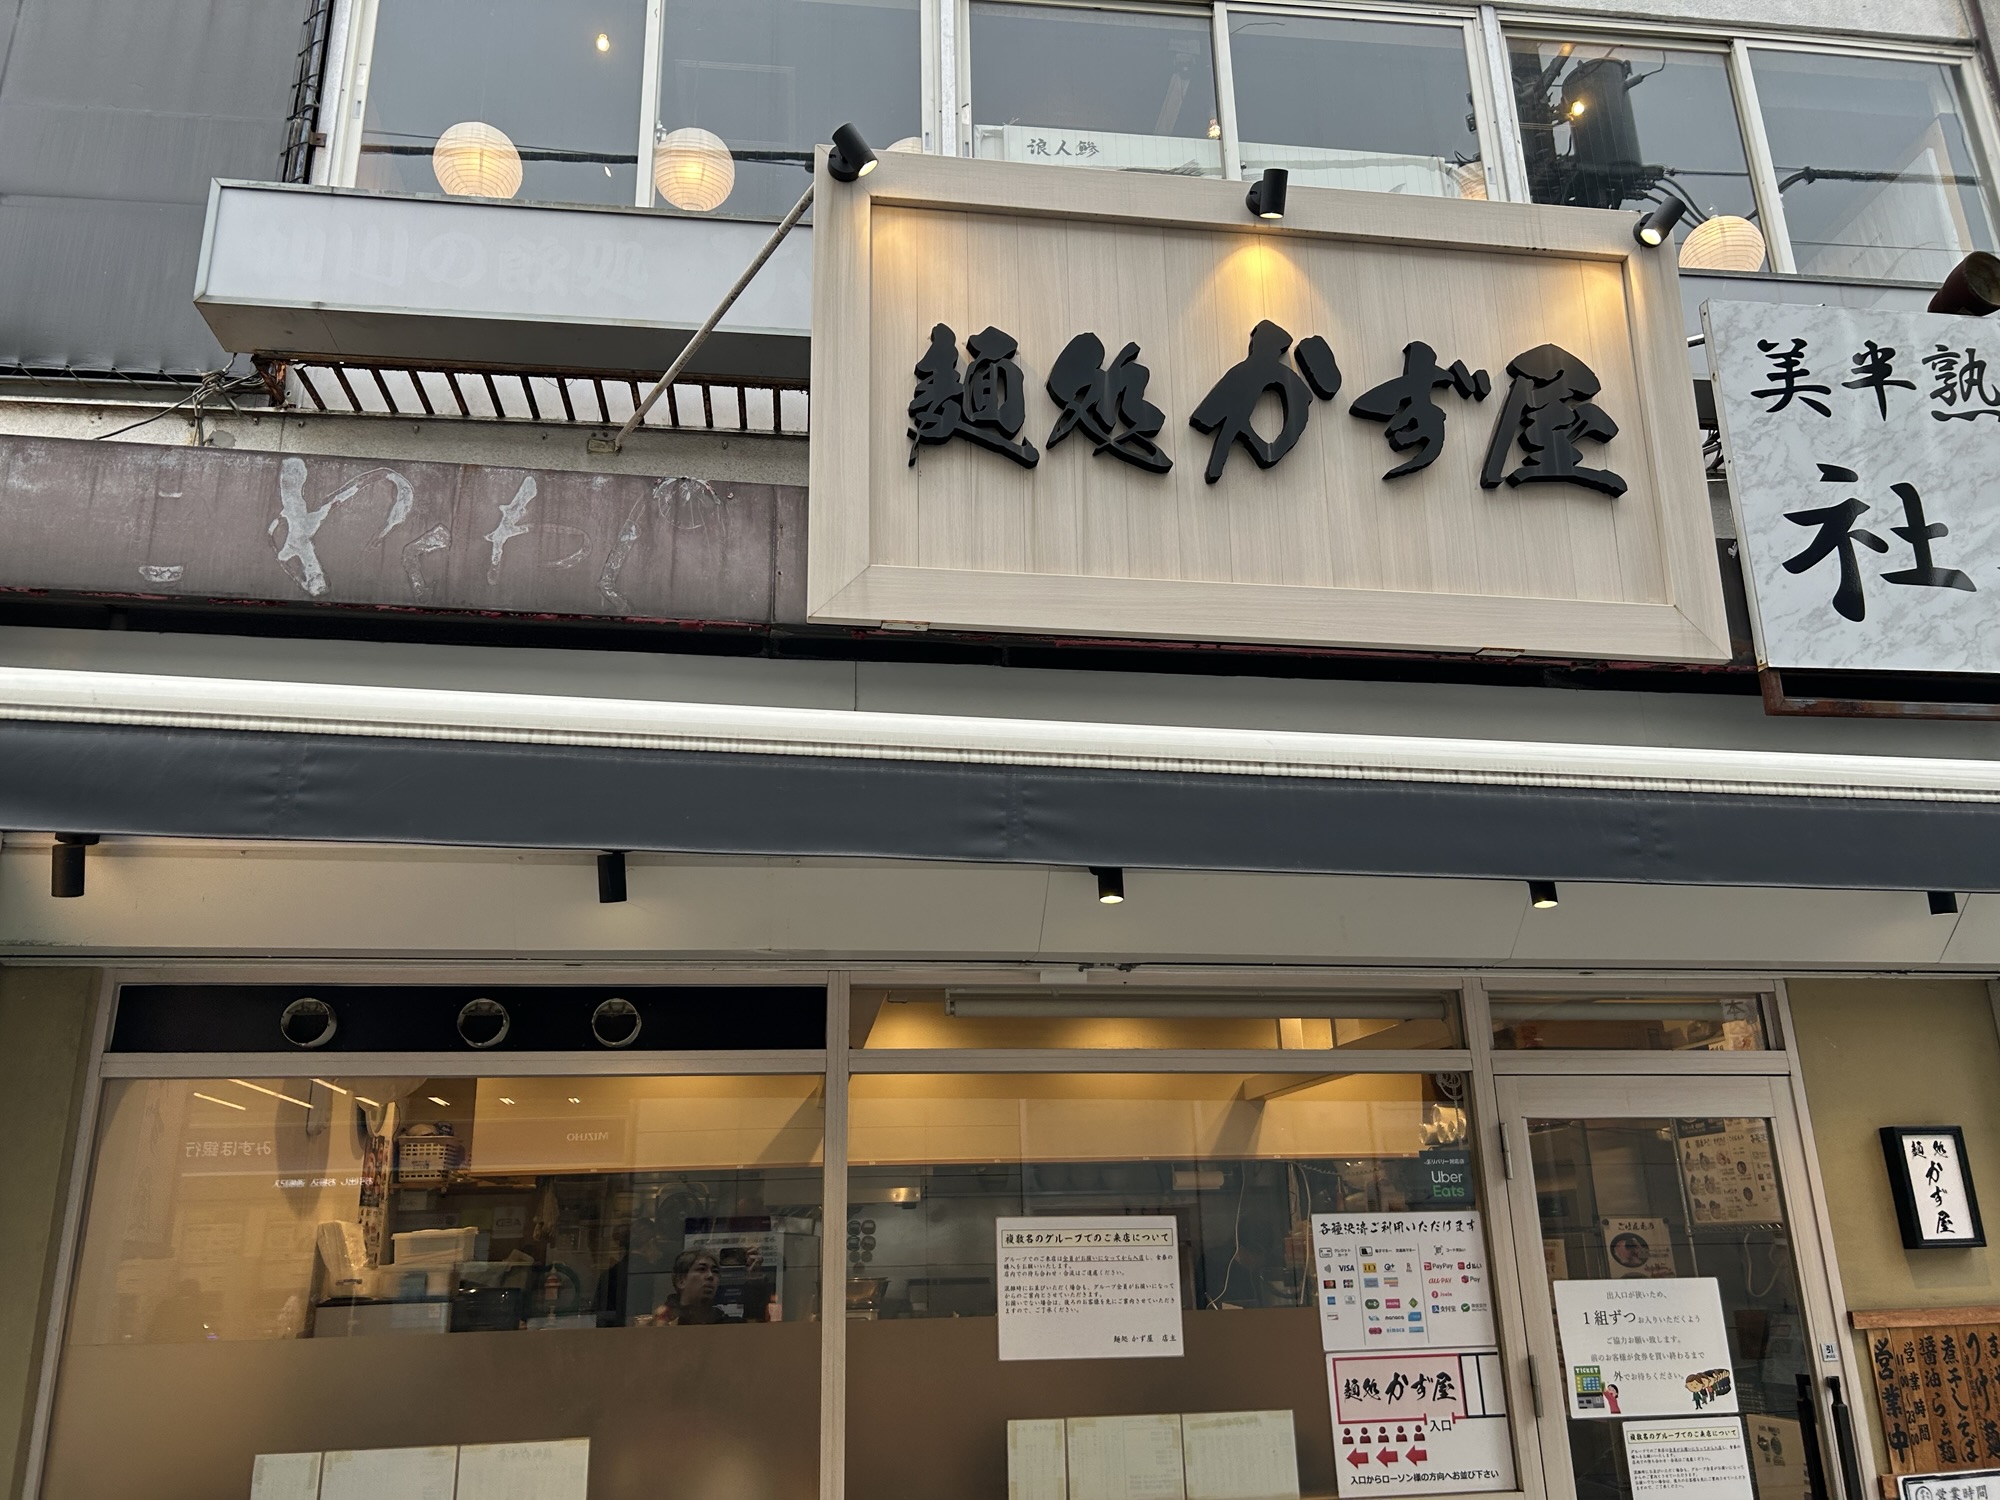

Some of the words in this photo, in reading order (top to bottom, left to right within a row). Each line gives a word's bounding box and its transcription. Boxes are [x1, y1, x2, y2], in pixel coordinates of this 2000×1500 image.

[1431, 1171, 1463, 1183] Uber
[1433, 1185, 1465, 1198] Eats
[1925, 1161, 1955, 1235] かず屋
[1319, 1219, 1475, 1236] 各種決済ご利用いただけます
[1005, 1232, 1169, 1245] 複数名のグループでのご来店について
[1339, 1264, 1355, 1272] VISA
[1433, 1262, 1453, 1270] PayPay
[1162, 1334, 1177, 1342] 店主
[1606, 1336, 1682, 1345] ご協力お願い致します。
[1590, 1351, 1705, 1363] 前のお客様が食券を買い終わるまで
[1613, 1371, 1684, 1381] 外でお待ちください。
[1904, 1341, 1931, 1442] 営業時間
[1874, 1337, 1909, 1464] 営業中
[1941, 1335, 1979, 1463] 煮干しそば
[1430, 1420, 1452, 1432] 入口
[1350, 1470, 1499, 1485] 入口からローソン様の方向へお並び下さい
